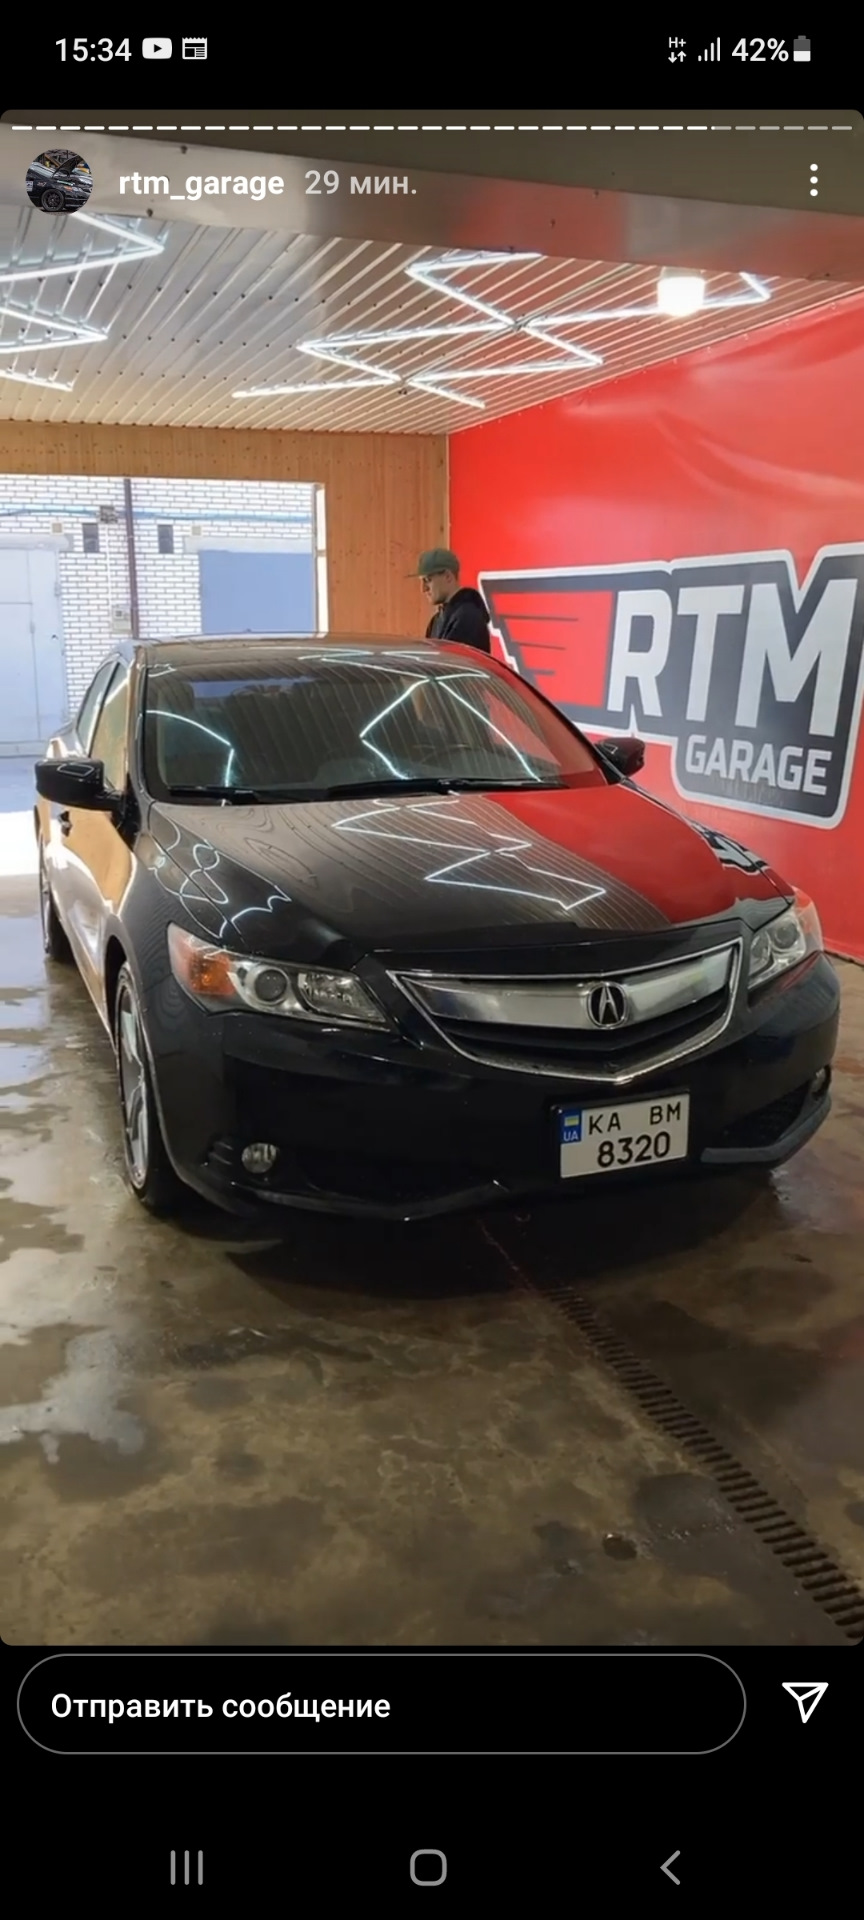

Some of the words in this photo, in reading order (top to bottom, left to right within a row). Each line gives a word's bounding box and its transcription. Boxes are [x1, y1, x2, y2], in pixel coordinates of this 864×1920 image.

[607, 578, 858, 737] RTM
[685, 734, 832, 796] GARAGE
[563, 1131, 579, 1142] UA
[588, 1112, 621, 1135] KA
[650, 1101, 681, 1125] BM
[597, 1131, 671, 1168] 8320
